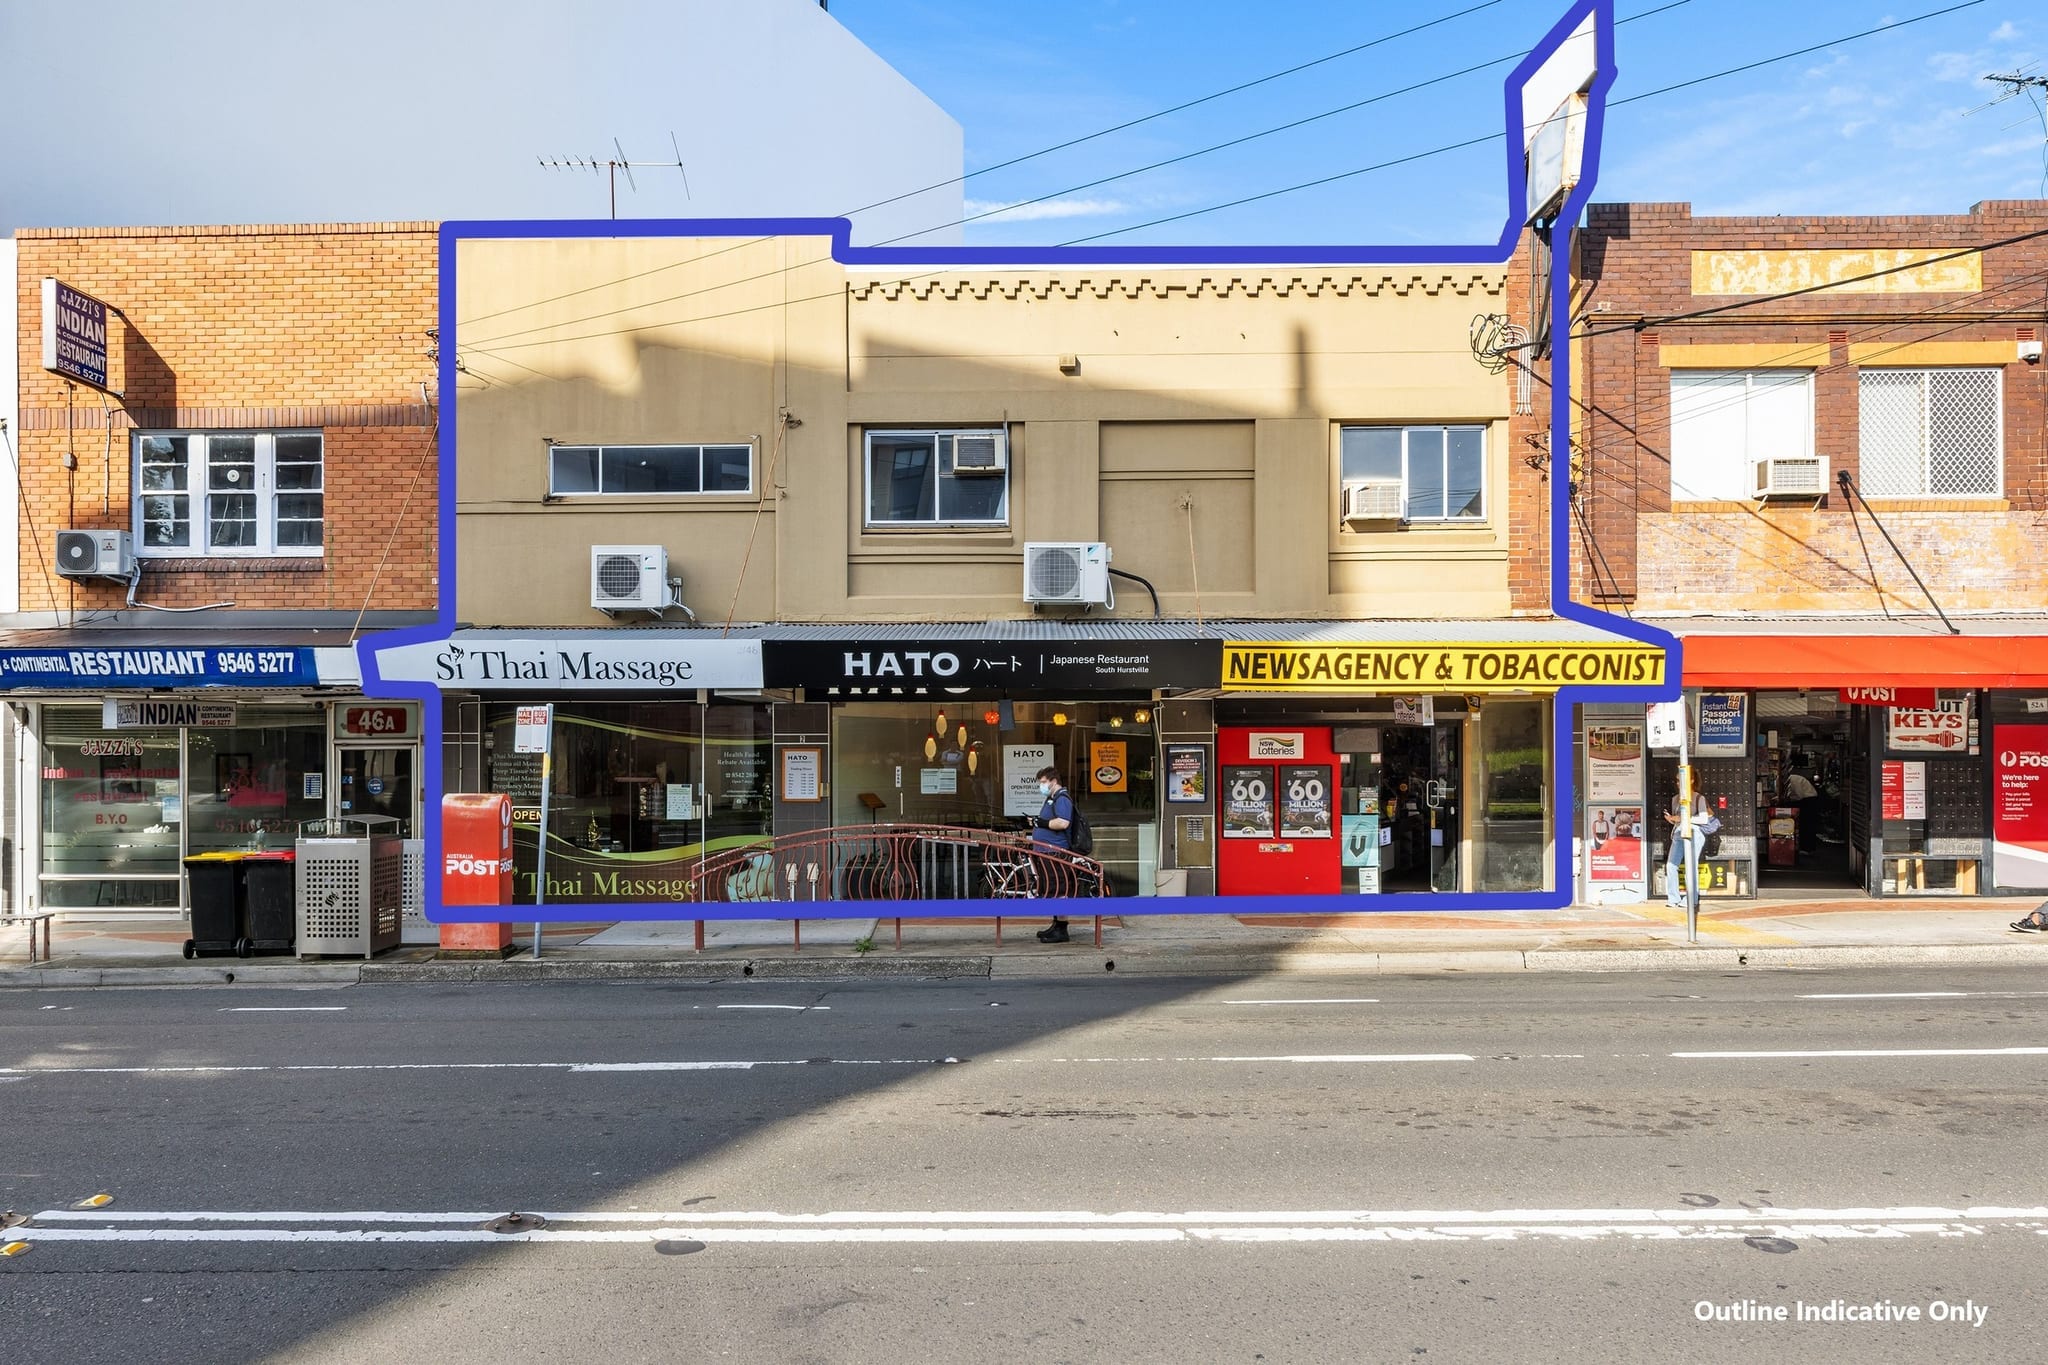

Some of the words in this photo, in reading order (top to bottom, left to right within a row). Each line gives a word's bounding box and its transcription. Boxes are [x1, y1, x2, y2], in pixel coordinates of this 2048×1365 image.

[57, 303, 105, 346] INDIAN
[62, 332, 106, 354] CONTINENTAL
[57, 338, 106, 373] RESTAURANT
[58, 359, 80, 375] 9546
[83, 366, 104, 384] 5277
[2, 660, 10, 670] &
[10, 656, 70, 672] CONTINENTAL
[68, 651, 206, 676] RESTAURANT
[218, 652, 256, 673] 9546
[258, 652, 294, 673] 5277
[436, 645, 464, 681] Si
[471, 651, 550, 680] Thai
[559, 651, 694, 687] Massage
[844, 652, 960, 676] HATO
[973, 656, 1022, 672] ハート
[1050, 654, 1094, 665] Japanese
[1097, 654, 1150, 664] Restaurant
[1229, 652, 1430, 680] NEWSAGENCY
[1434, 652, 1452, 680] &
[1462, 653, 1666, 680] TOBACCONIST
[140, 704, 197, 724] INDIAN
[358, 710, 394, 730] 46A
[1702, 710, 1740, 718] Passport
[1894, 714, 1962, 728] KEYS
[96, 814, 128, 824] B.Y.O
[446, 860, 499, 875] POST
[592, 872, 698, 900] Massage
